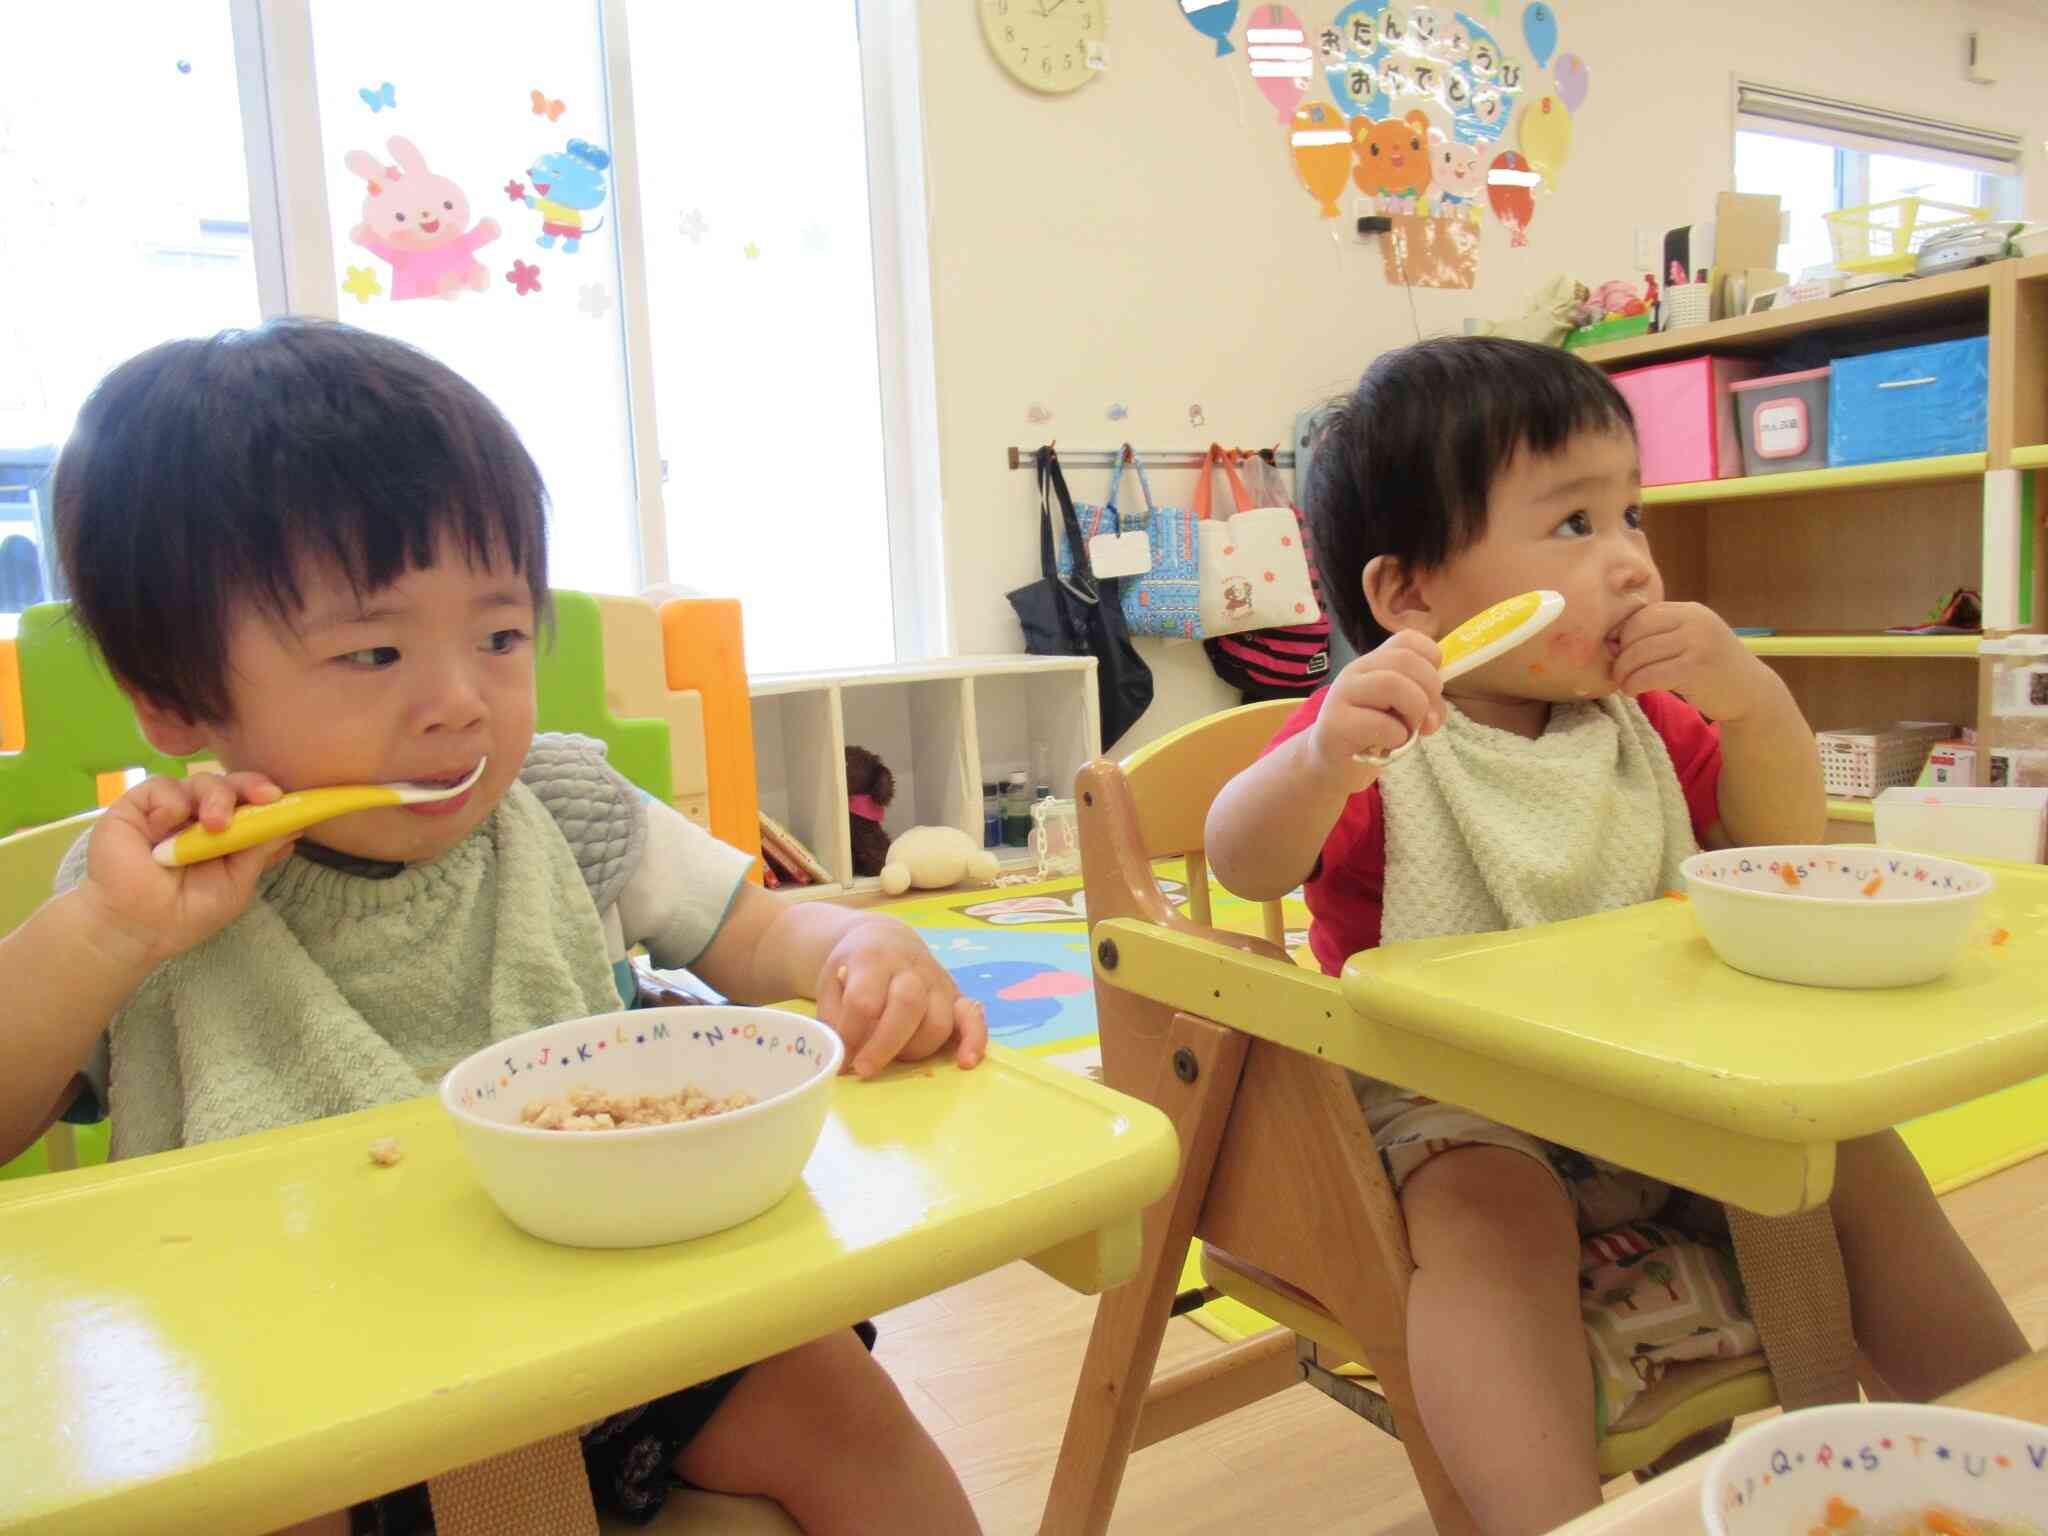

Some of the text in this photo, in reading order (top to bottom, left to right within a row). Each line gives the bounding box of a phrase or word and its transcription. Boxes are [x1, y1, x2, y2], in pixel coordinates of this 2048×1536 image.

[538, 1047, 551, 1066] J
[576, 1043, 592, 1061] K
[616, 1024, 627, 1044] L
[653, 1024, 670, 1040] M
[705, 1026, 724, 1047] N
[743, 1024, 758, 1040] O
[1771, 1449, 1791, 1475] Q
[1816, 1443, 1833, 1467] R
[1859, 1446, 1879, 1471] S
[1906, 1436, 1925, 1456] T
